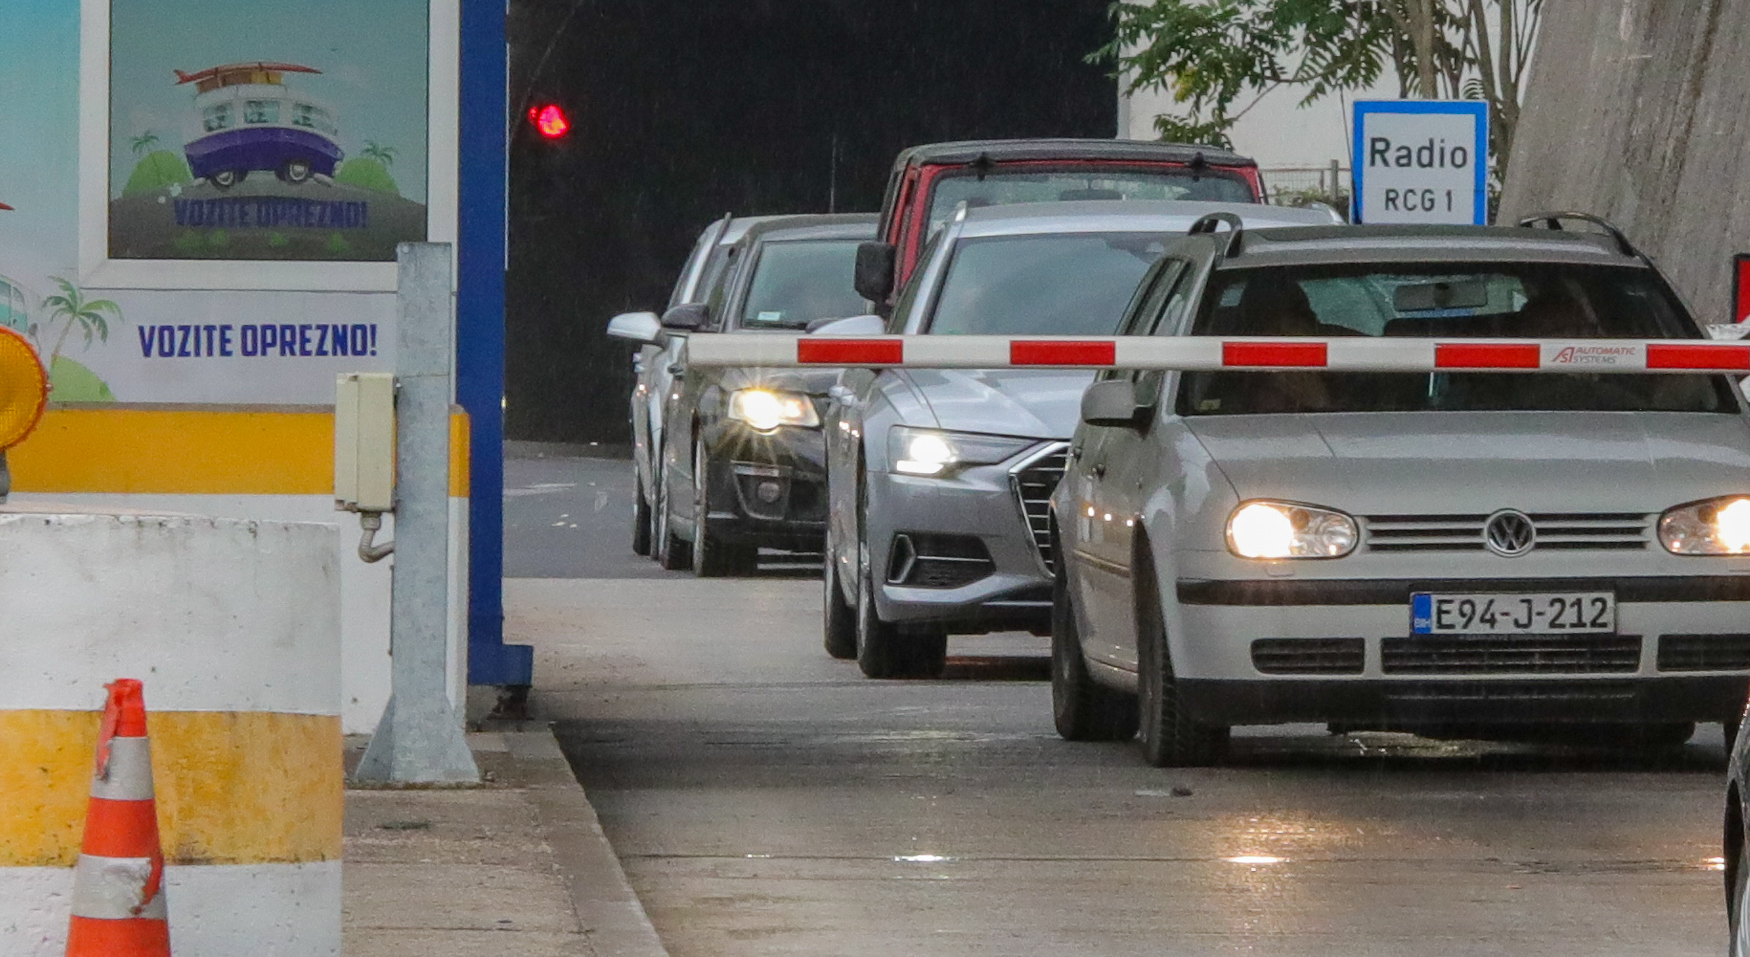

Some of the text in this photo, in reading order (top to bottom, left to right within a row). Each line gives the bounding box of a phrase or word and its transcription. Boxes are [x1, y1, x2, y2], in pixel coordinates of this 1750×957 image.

[1370, 137, 1468, 168] Radio
[174, 198, 368, 229] VOZITE OPREZNO!
[1385, 188, 1453, 212] RCG 1
[138, 324, 378, 358] VOZITE OPREZNO!
[1575, 346, 1636, 355] AUTOMATIC
[1573, 355, 1616, 363] SYSTEMS
[1436, 597, 1608, 629] E94-J-212
